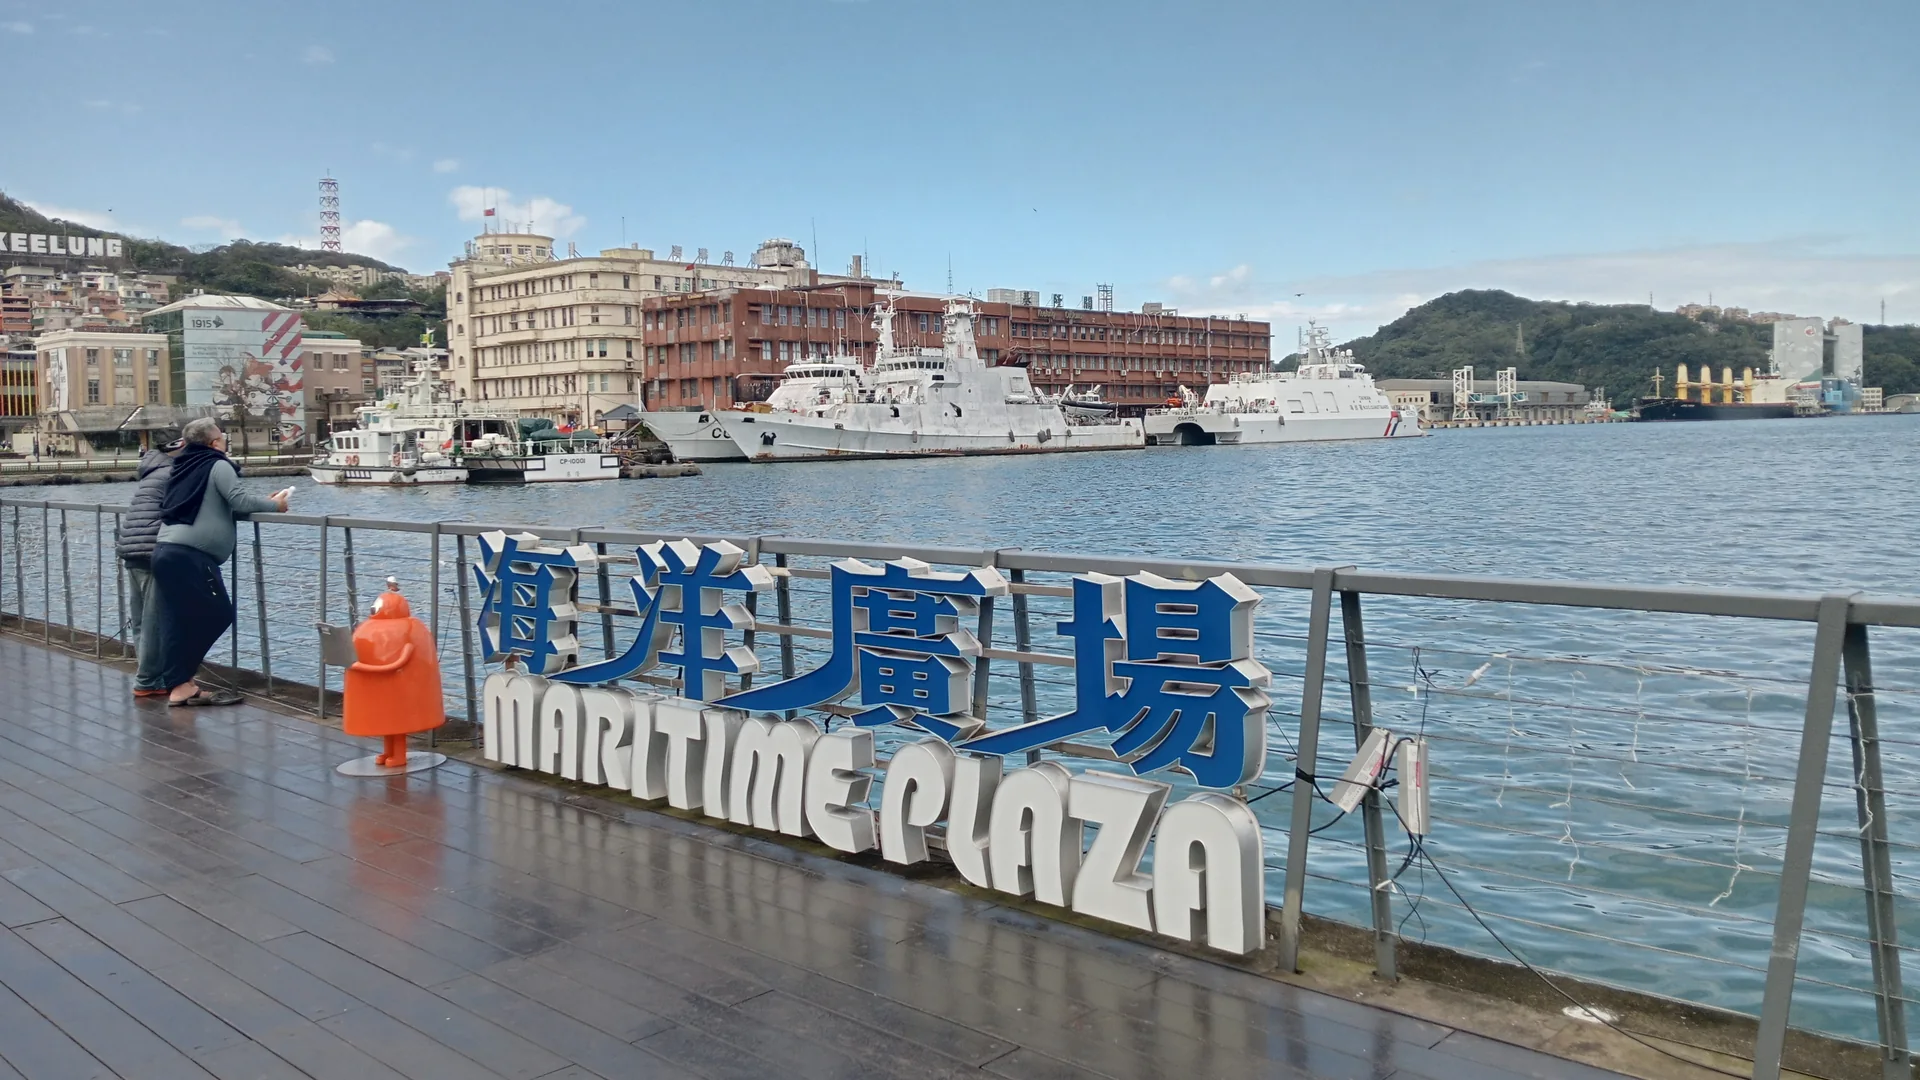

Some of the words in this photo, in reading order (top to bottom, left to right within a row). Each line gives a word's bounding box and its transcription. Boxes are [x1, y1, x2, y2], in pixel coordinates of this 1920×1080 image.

[191, 319, 213, 328] 1915
[473, 530, 1273, 789] 海洋廣場
[483, 668, 878, 854] MARITIME
[880, 736, 1266, 956] PLAZA
